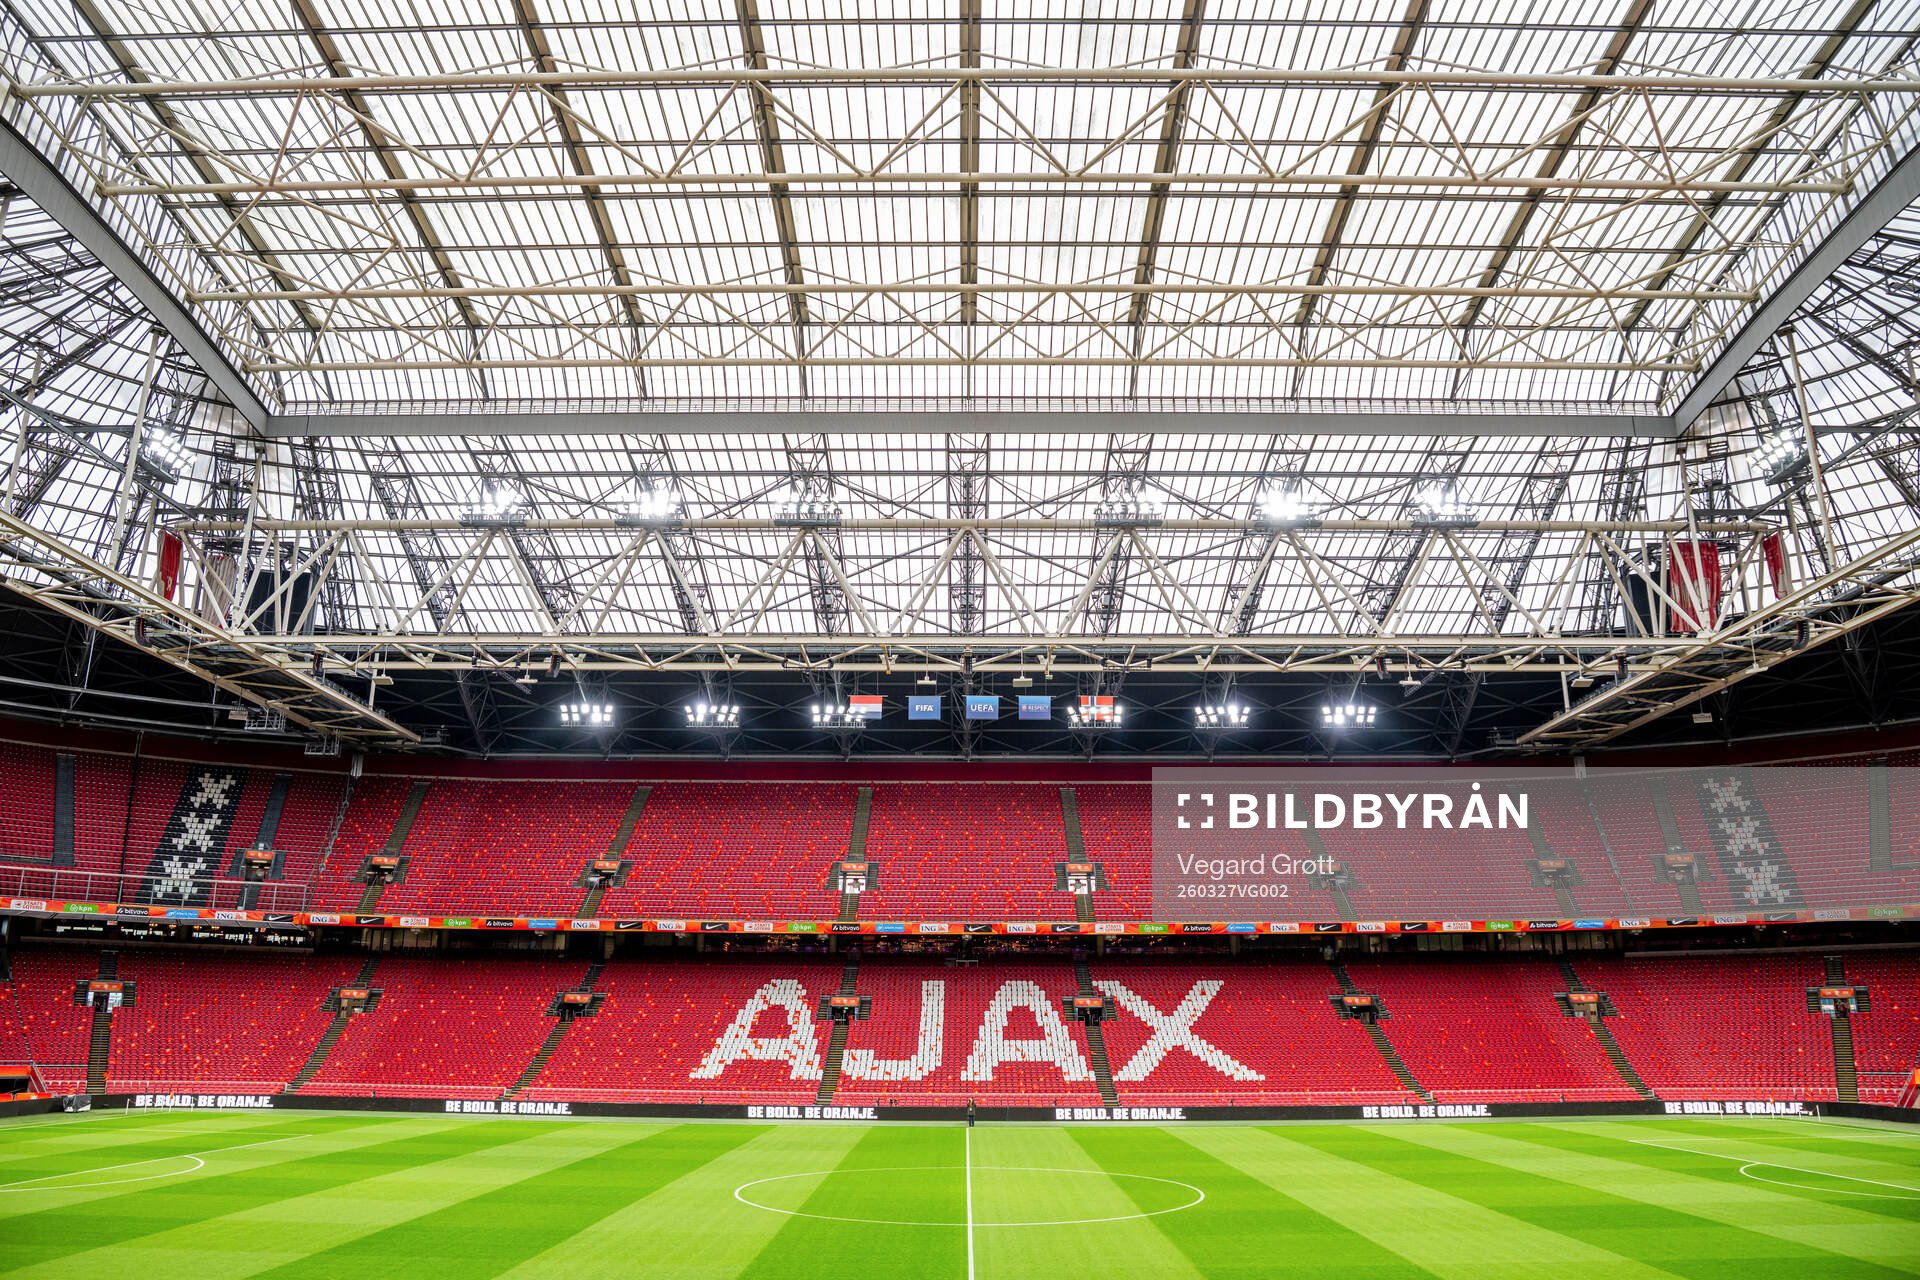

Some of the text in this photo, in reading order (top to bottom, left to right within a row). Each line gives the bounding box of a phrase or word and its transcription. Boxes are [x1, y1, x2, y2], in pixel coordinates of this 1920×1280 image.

[915, 704, 934, 712] FIFA
[970, 704, 994, 712] UEFA
[79, 904, 93, 912] kpn
[124, 907, 149, 915] bitvavo
[1883, 907, 1898, 915] kpn
[217, 912, 233, 920] ING
[689, 979, 1266, 1081] AJAX
[135, 1095, 153, 1107] BE
[198, 1095, 215, 1107] BE
[445, 1100, 572, 1114] BE BOLD. BE ORANJE.
[748, 1106, 878, 1119] BE BOLD. BE ORANJE.
[1056, 1108, 1186, 1120] BE BOLD. BE ORANJE.
[1363, 1104, 1492, 1118] BE BOLD. BE ORANJE.
[1664, 1102, 1682, 1114] BE
[1725, 1102, 1743, 1114] BE
